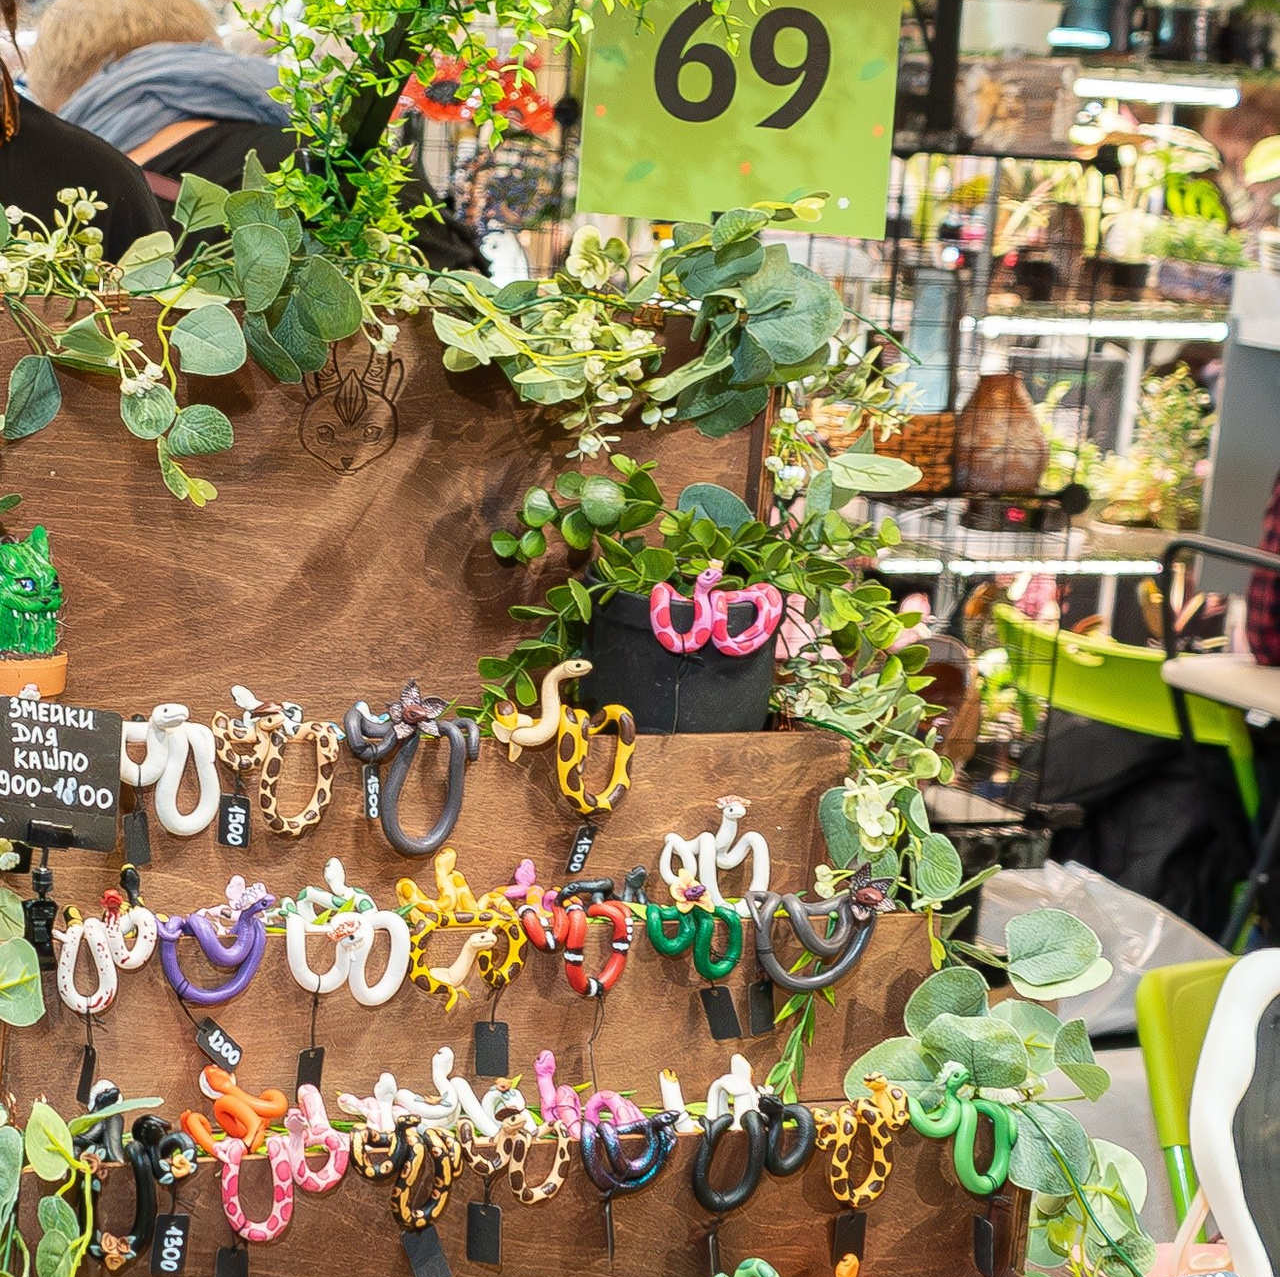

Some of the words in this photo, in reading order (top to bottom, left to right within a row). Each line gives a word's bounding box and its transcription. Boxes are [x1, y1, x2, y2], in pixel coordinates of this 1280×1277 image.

[653, 0, 832, 131] 69
[10, 721, 59, 748] ДЛЯ
[13, 746, 89, 773] КАШПО
[367, 775, 380, 819] 1500
[225, 804, 247, 846] 1500
[568, 836, 593, 873] 1500
[207, 1029, 241, 1066] 1200
[159, 1224, 184, 1273] 1300
